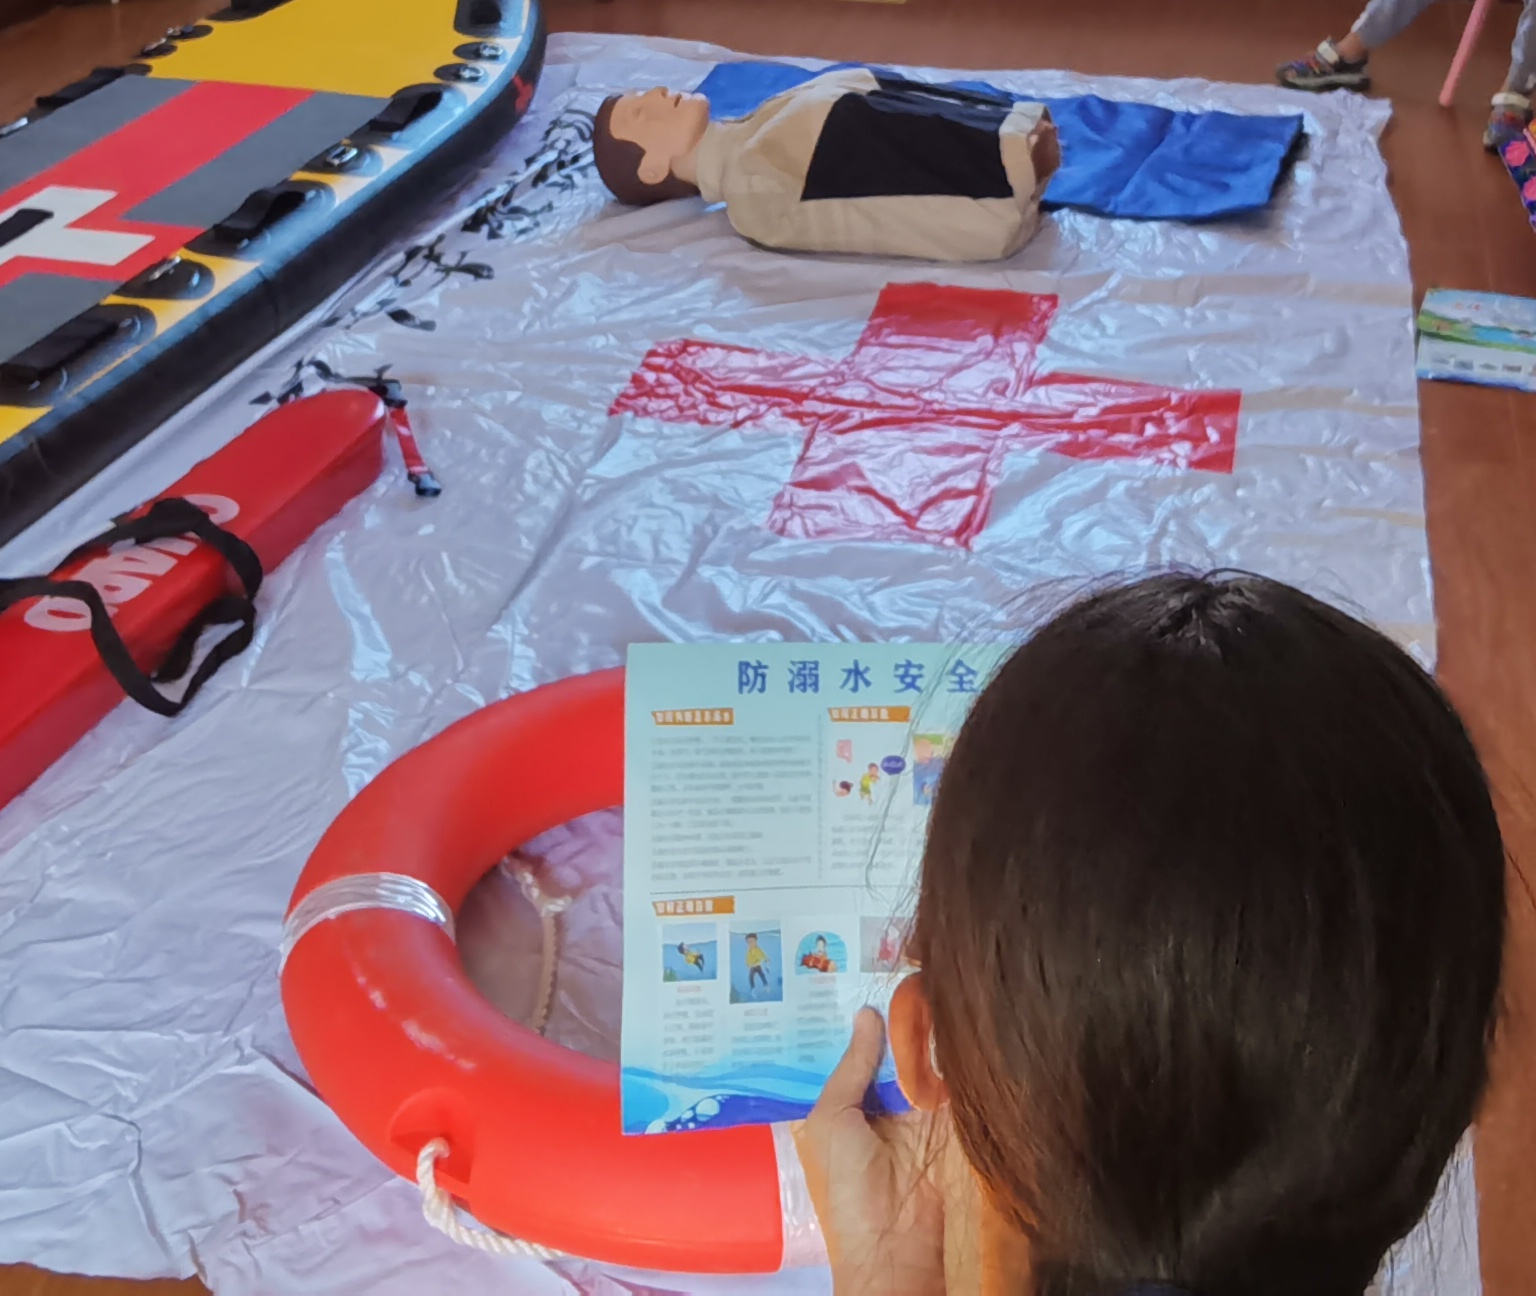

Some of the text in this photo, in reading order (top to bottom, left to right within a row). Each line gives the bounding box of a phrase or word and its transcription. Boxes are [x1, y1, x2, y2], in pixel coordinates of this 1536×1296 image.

[736, 658, 980, 695] 防溺水安全
